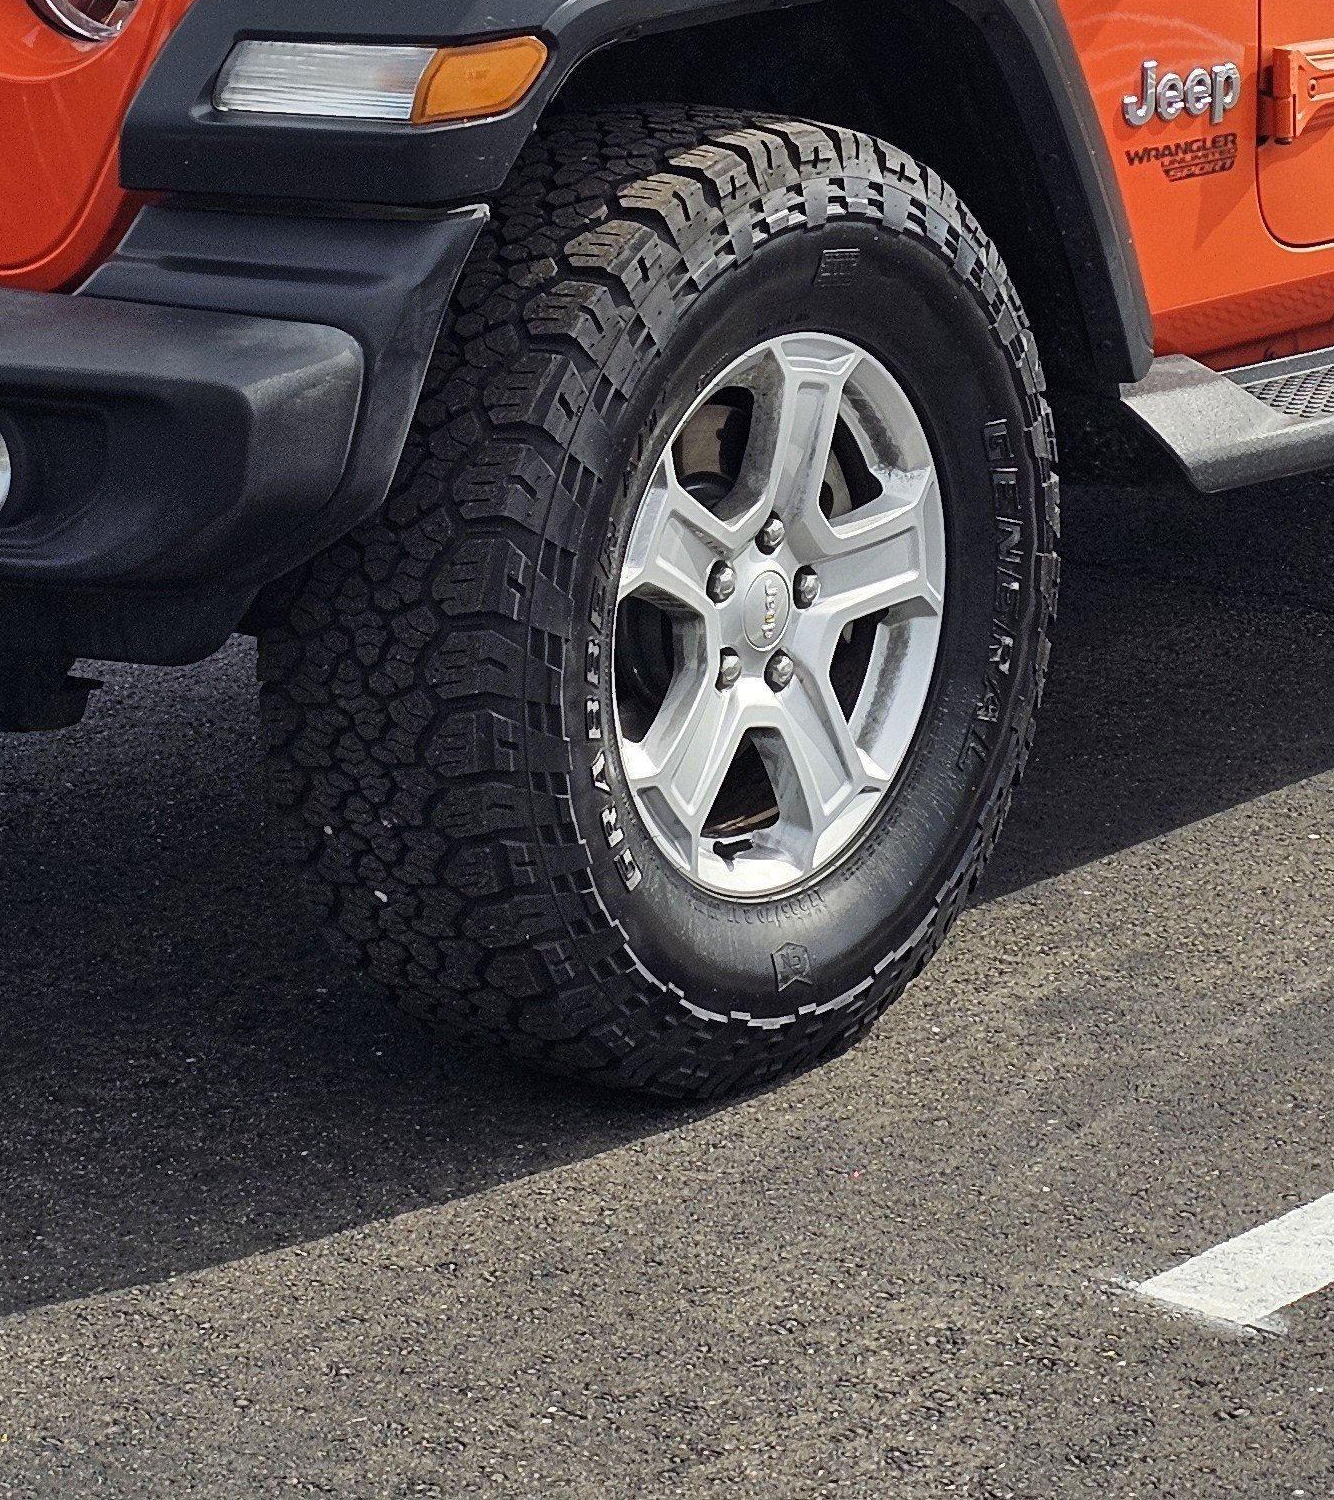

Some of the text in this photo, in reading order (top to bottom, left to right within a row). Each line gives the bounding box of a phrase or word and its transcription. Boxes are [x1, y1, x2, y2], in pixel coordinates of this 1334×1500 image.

[1122, 59, 1242, 126] Jeep
[1124, 133, 1238, 167] WRANGLER
[1167, 157, 1236, 180] SPORT
[956, 417, 1025, 773] GENERAL
[584, 518, 642, 893] GRABBER
